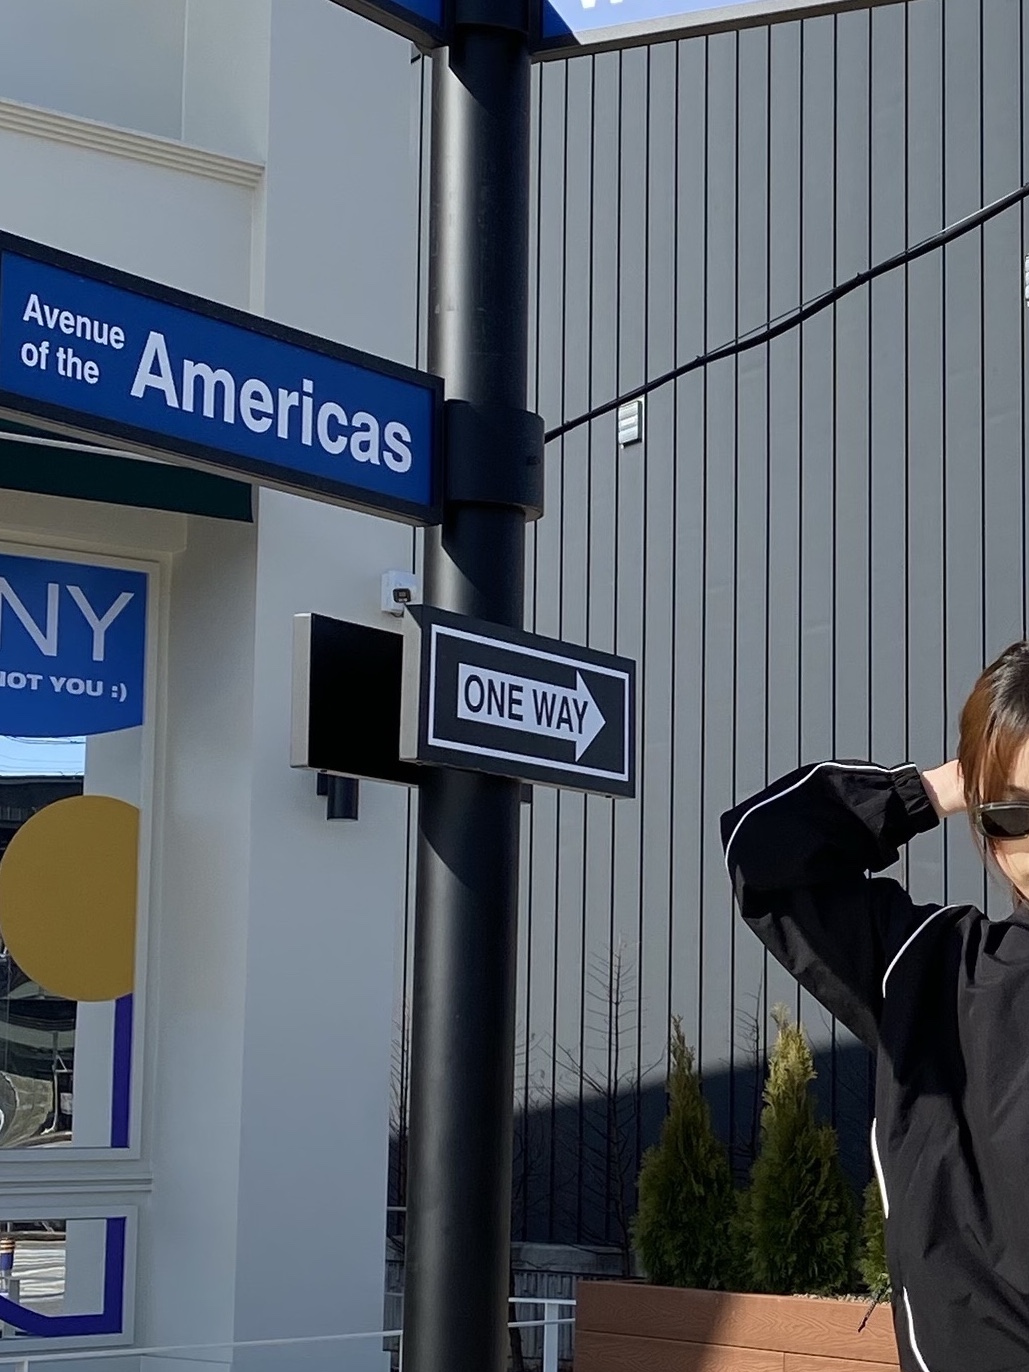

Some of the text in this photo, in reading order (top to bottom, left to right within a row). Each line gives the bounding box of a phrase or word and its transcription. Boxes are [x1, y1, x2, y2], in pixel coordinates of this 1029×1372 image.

[23, 293, 125, 349] Avenue
[21, 341, 99, 384] of the
[130, 331, 412, 473] Americas
[49, 675, 104, 697] YOU
[464, 674, 589, 735] ONE WAY
